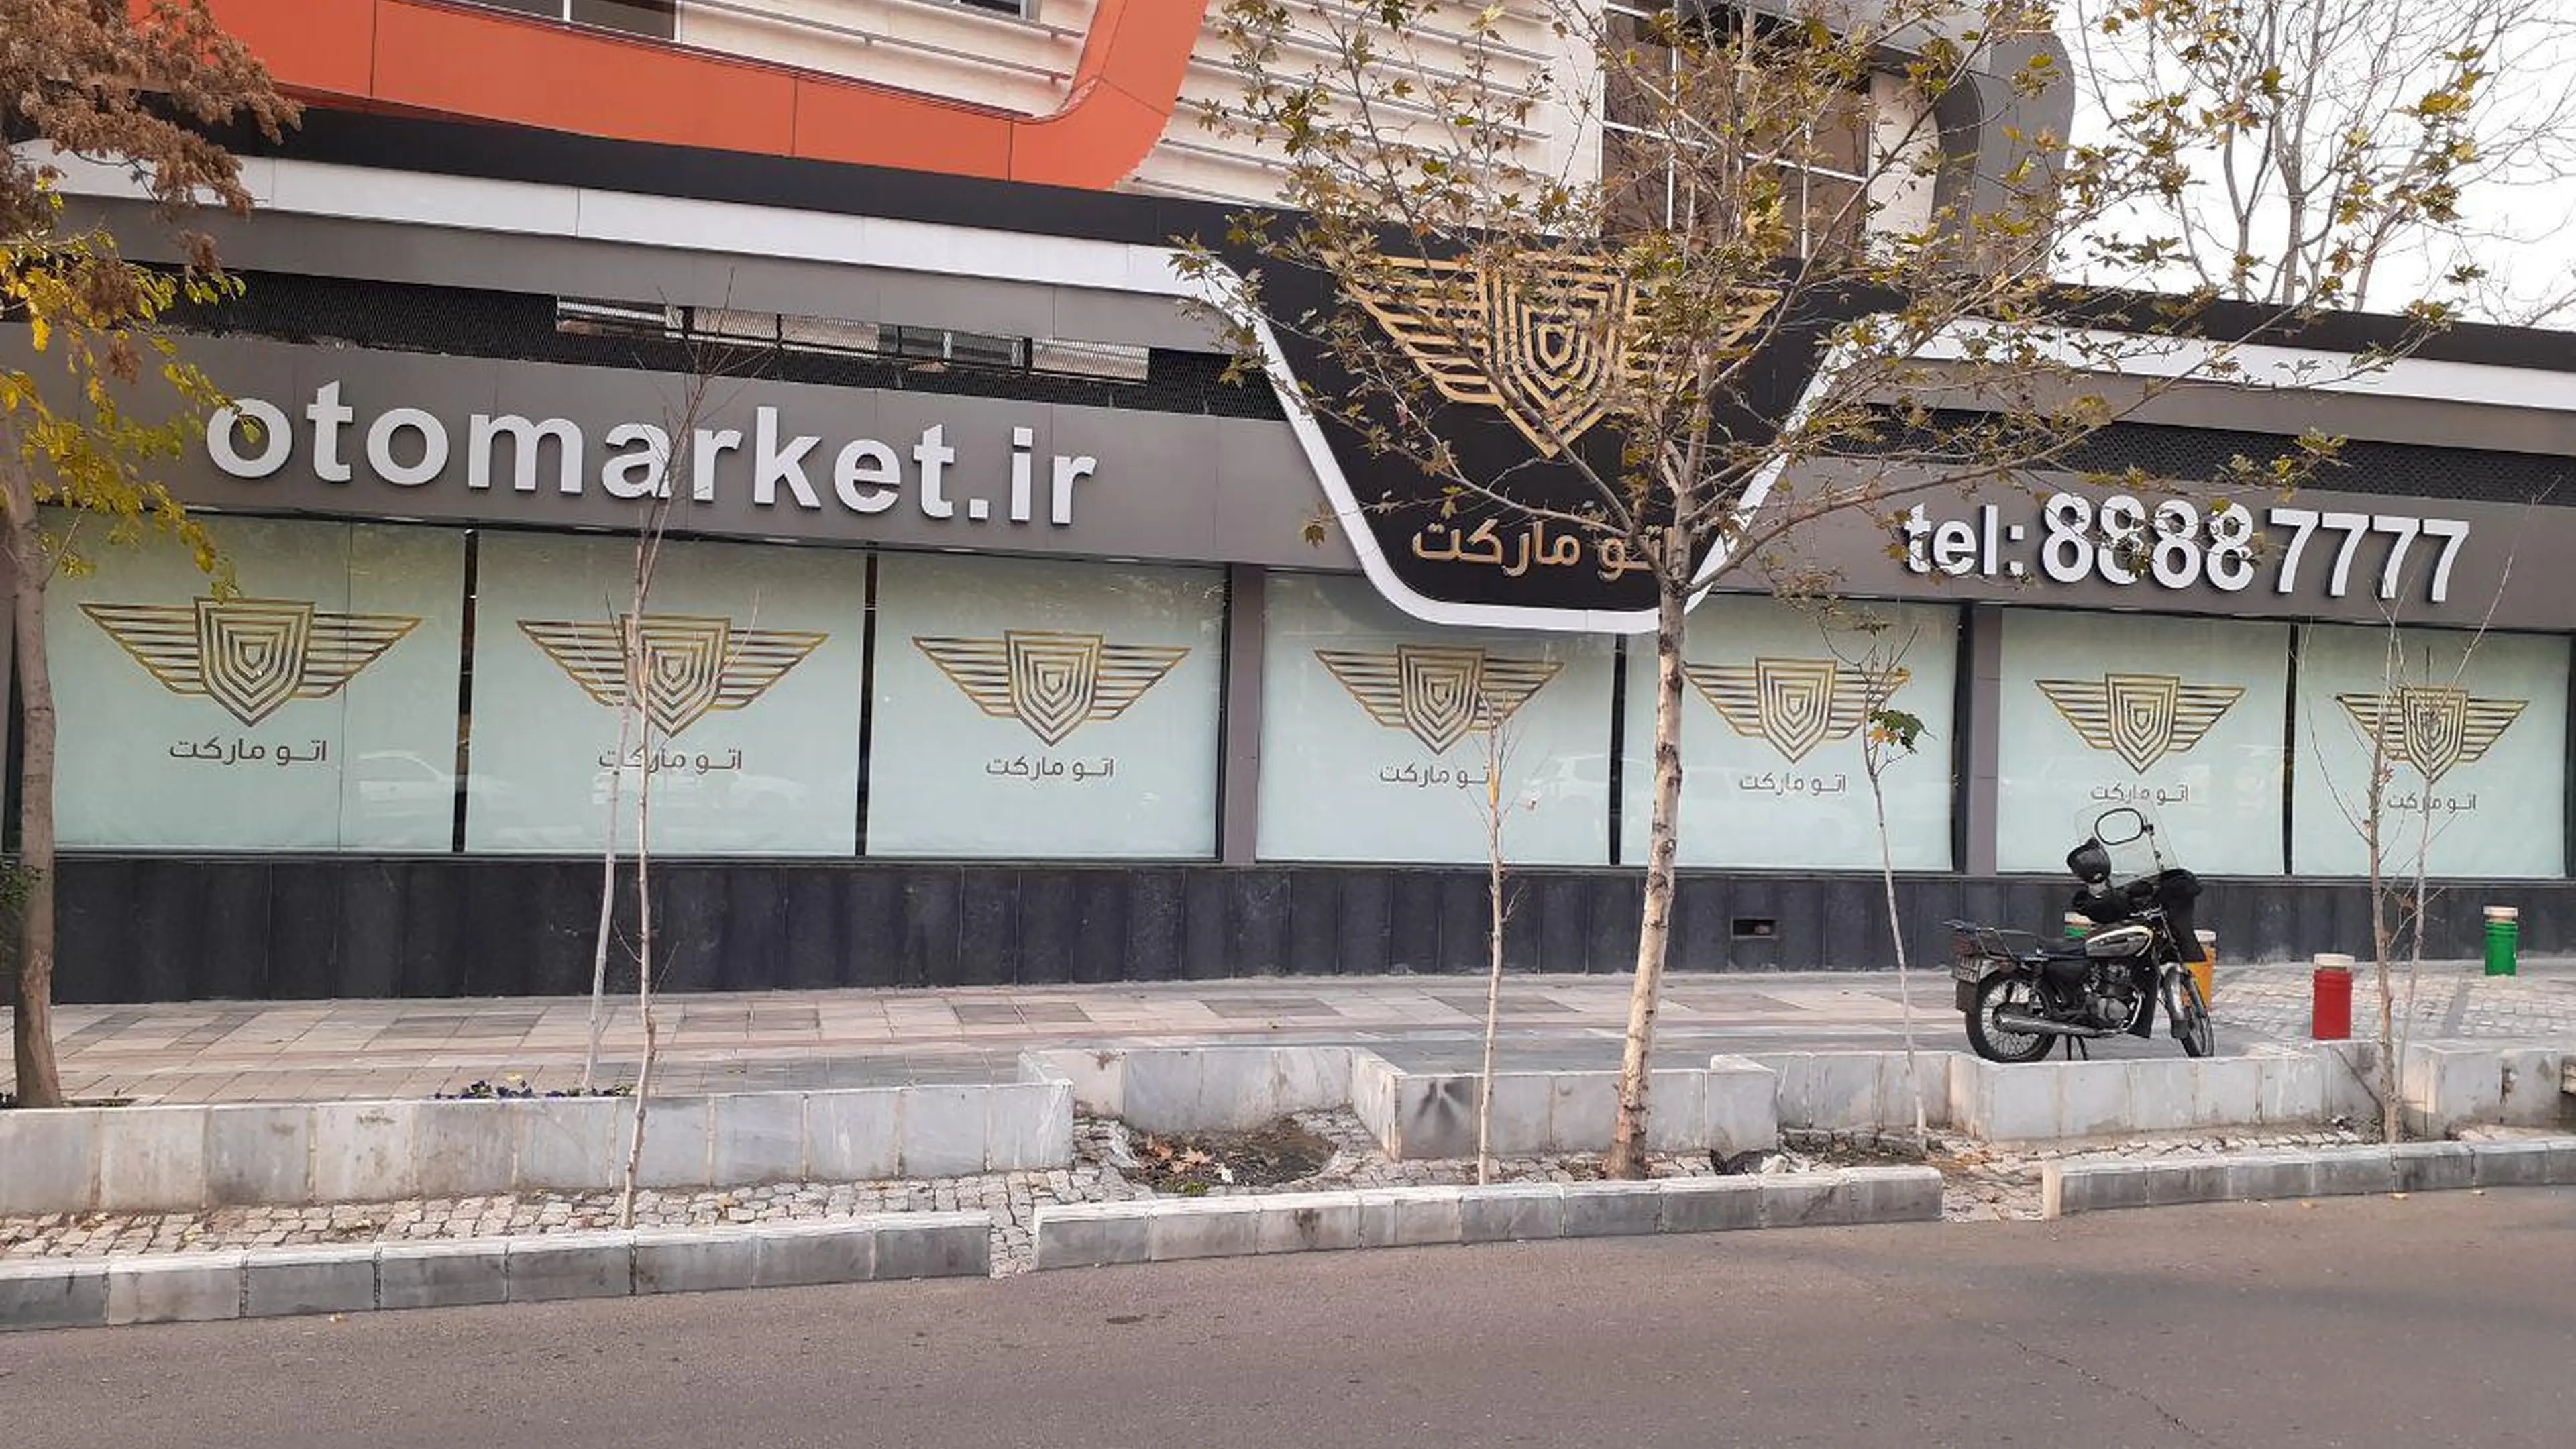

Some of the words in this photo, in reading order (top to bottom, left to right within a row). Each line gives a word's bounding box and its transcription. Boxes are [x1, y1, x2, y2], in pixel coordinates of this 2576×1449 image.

[207, 380, 1097, 525] otomarket.ir
[1412, 519, 1580, 577] مارکت
[170, 736, 265, 765] مارکت
[276, 740, 327, 765] اتو
[695, 748, 742, 775] اتو
[985, 756, 1064, 781] مارکت
[1072, 758, 1114, 782] اتو
[1379, 763, 1450, 788] مارکت
[1740, 772, 1805, 796] مارکت
[1811, 774, 1846, 796] اتو
[2157, 784, 2188, 806] اتو
